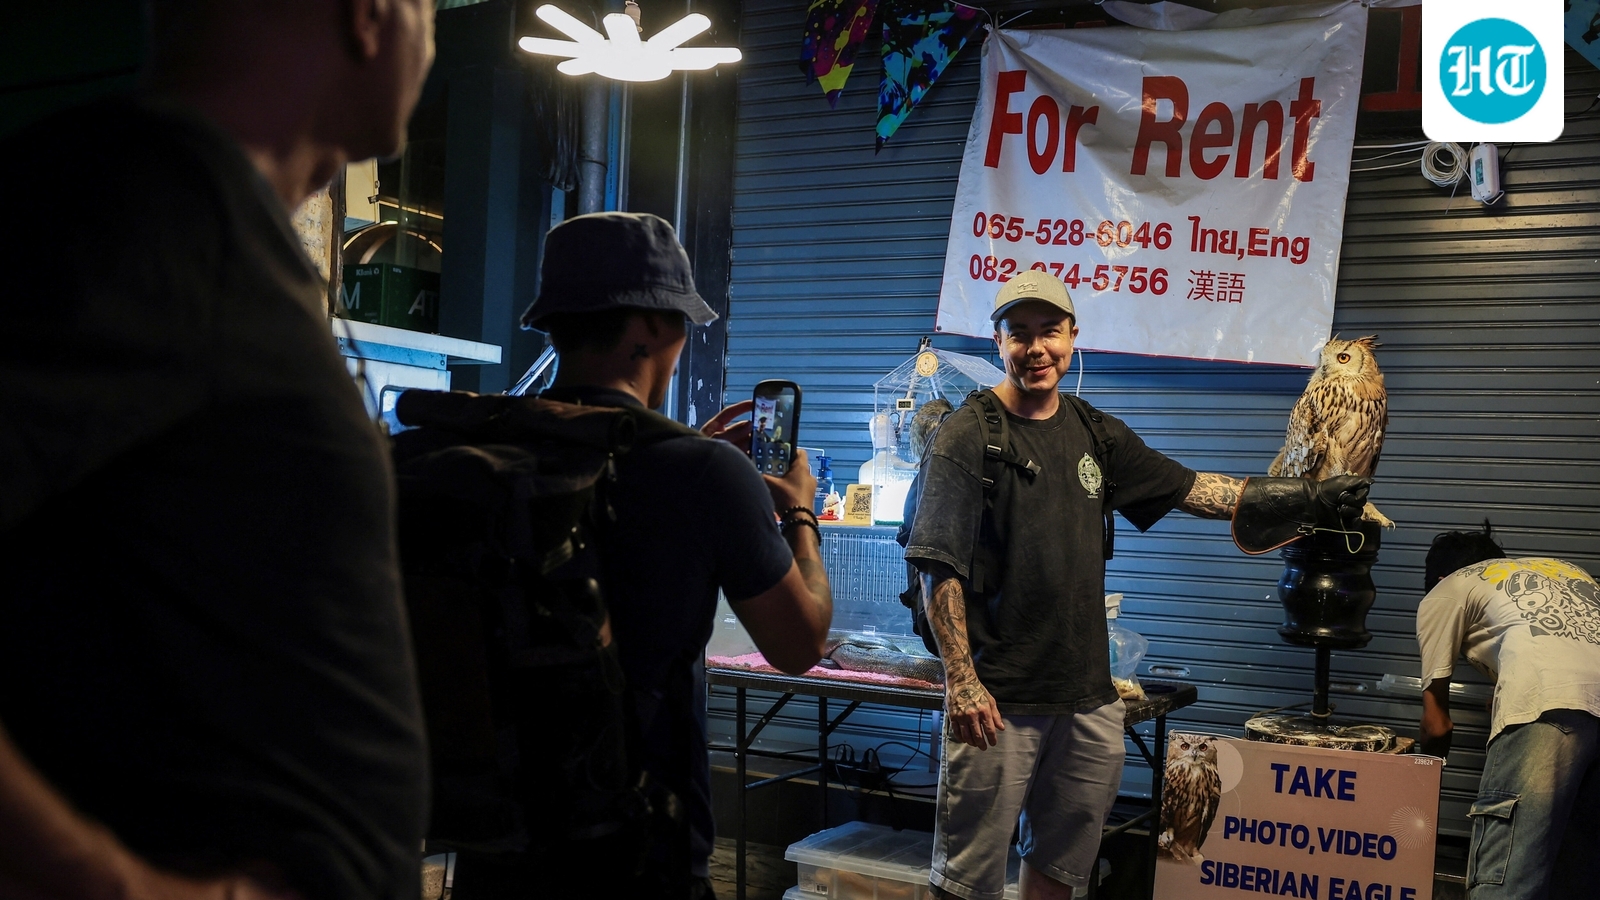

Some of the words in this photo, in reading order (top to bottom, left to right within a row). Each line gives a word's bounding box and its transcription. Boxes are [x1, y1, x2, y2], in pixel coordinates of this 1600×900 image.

[984, 70, 1100, 175] For
[1130, 76, 1321, 182] Rent
[973, 212, 1173, 250] 065-528-6046
[1186, 269, 1246, 303] 漢語
[1271, 763, 1356, 801] TAKE
[1223, 816, 1397, 861] PHOTO,VIDEO
[1200, 860, 1319, 900] SIBERIAN
